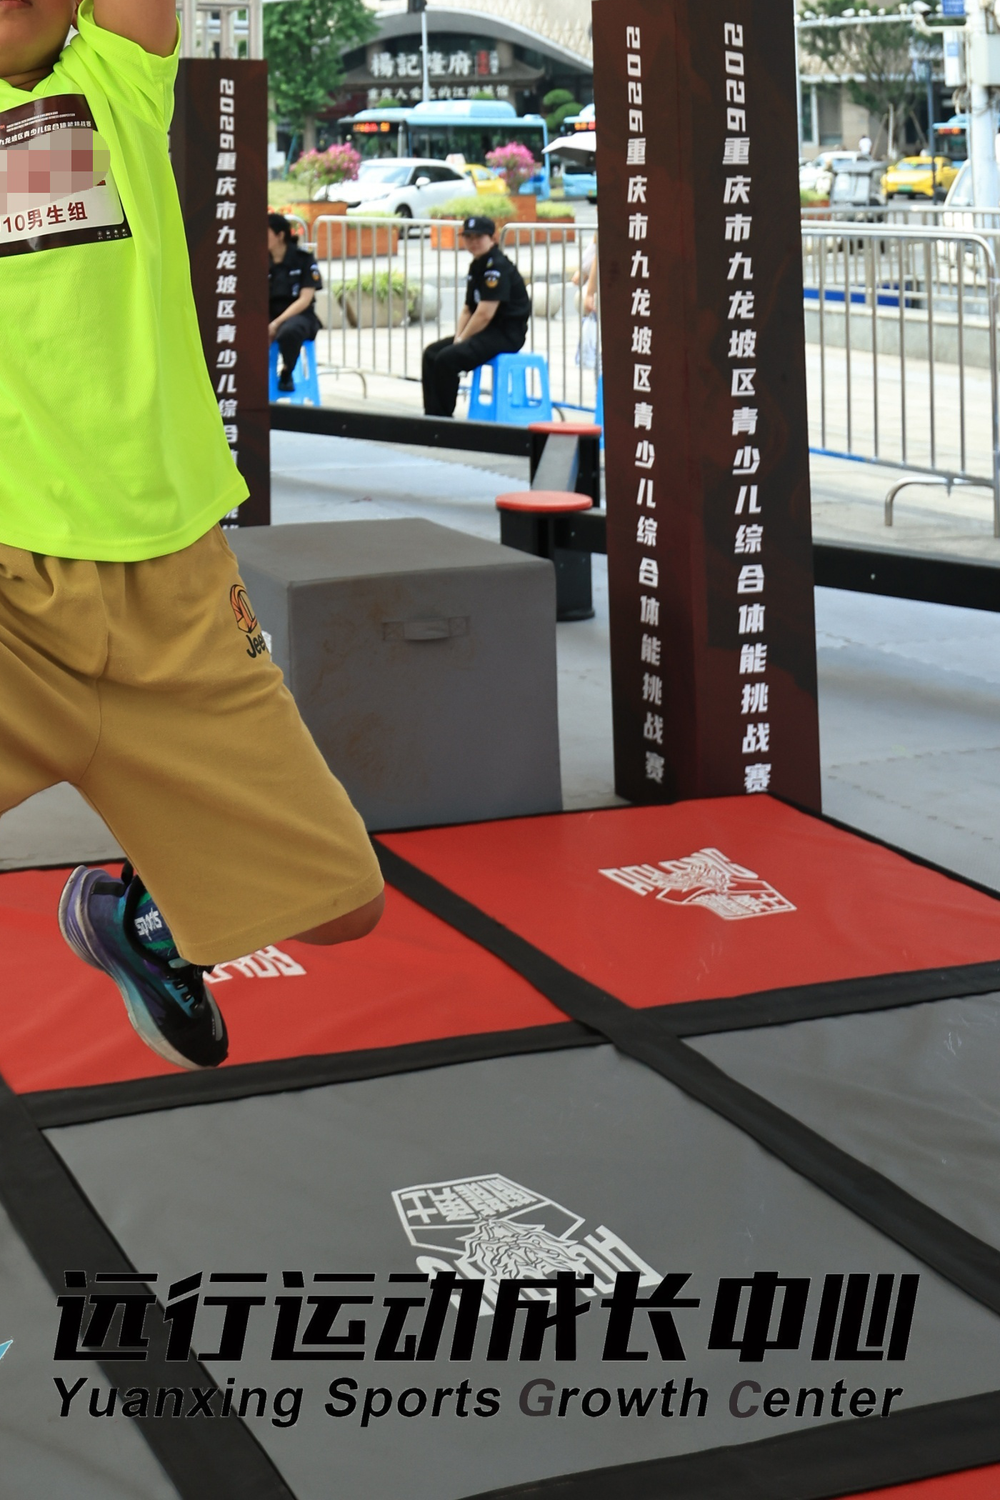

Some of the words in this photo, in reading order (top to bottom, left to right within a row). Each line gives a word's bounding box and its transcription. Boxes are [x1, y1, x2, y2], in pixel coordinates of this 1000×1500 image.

[626, 26, 666, 785] 2026重庆市九龙坡区青少儿综合体能挑战赛
[722, 22, 772, 793] 2026重庆市九龙坡区青少儿综合体能挑战赛
[246, 632, 270, 658] Jee
[202, 944, 307, 984] AOLO
